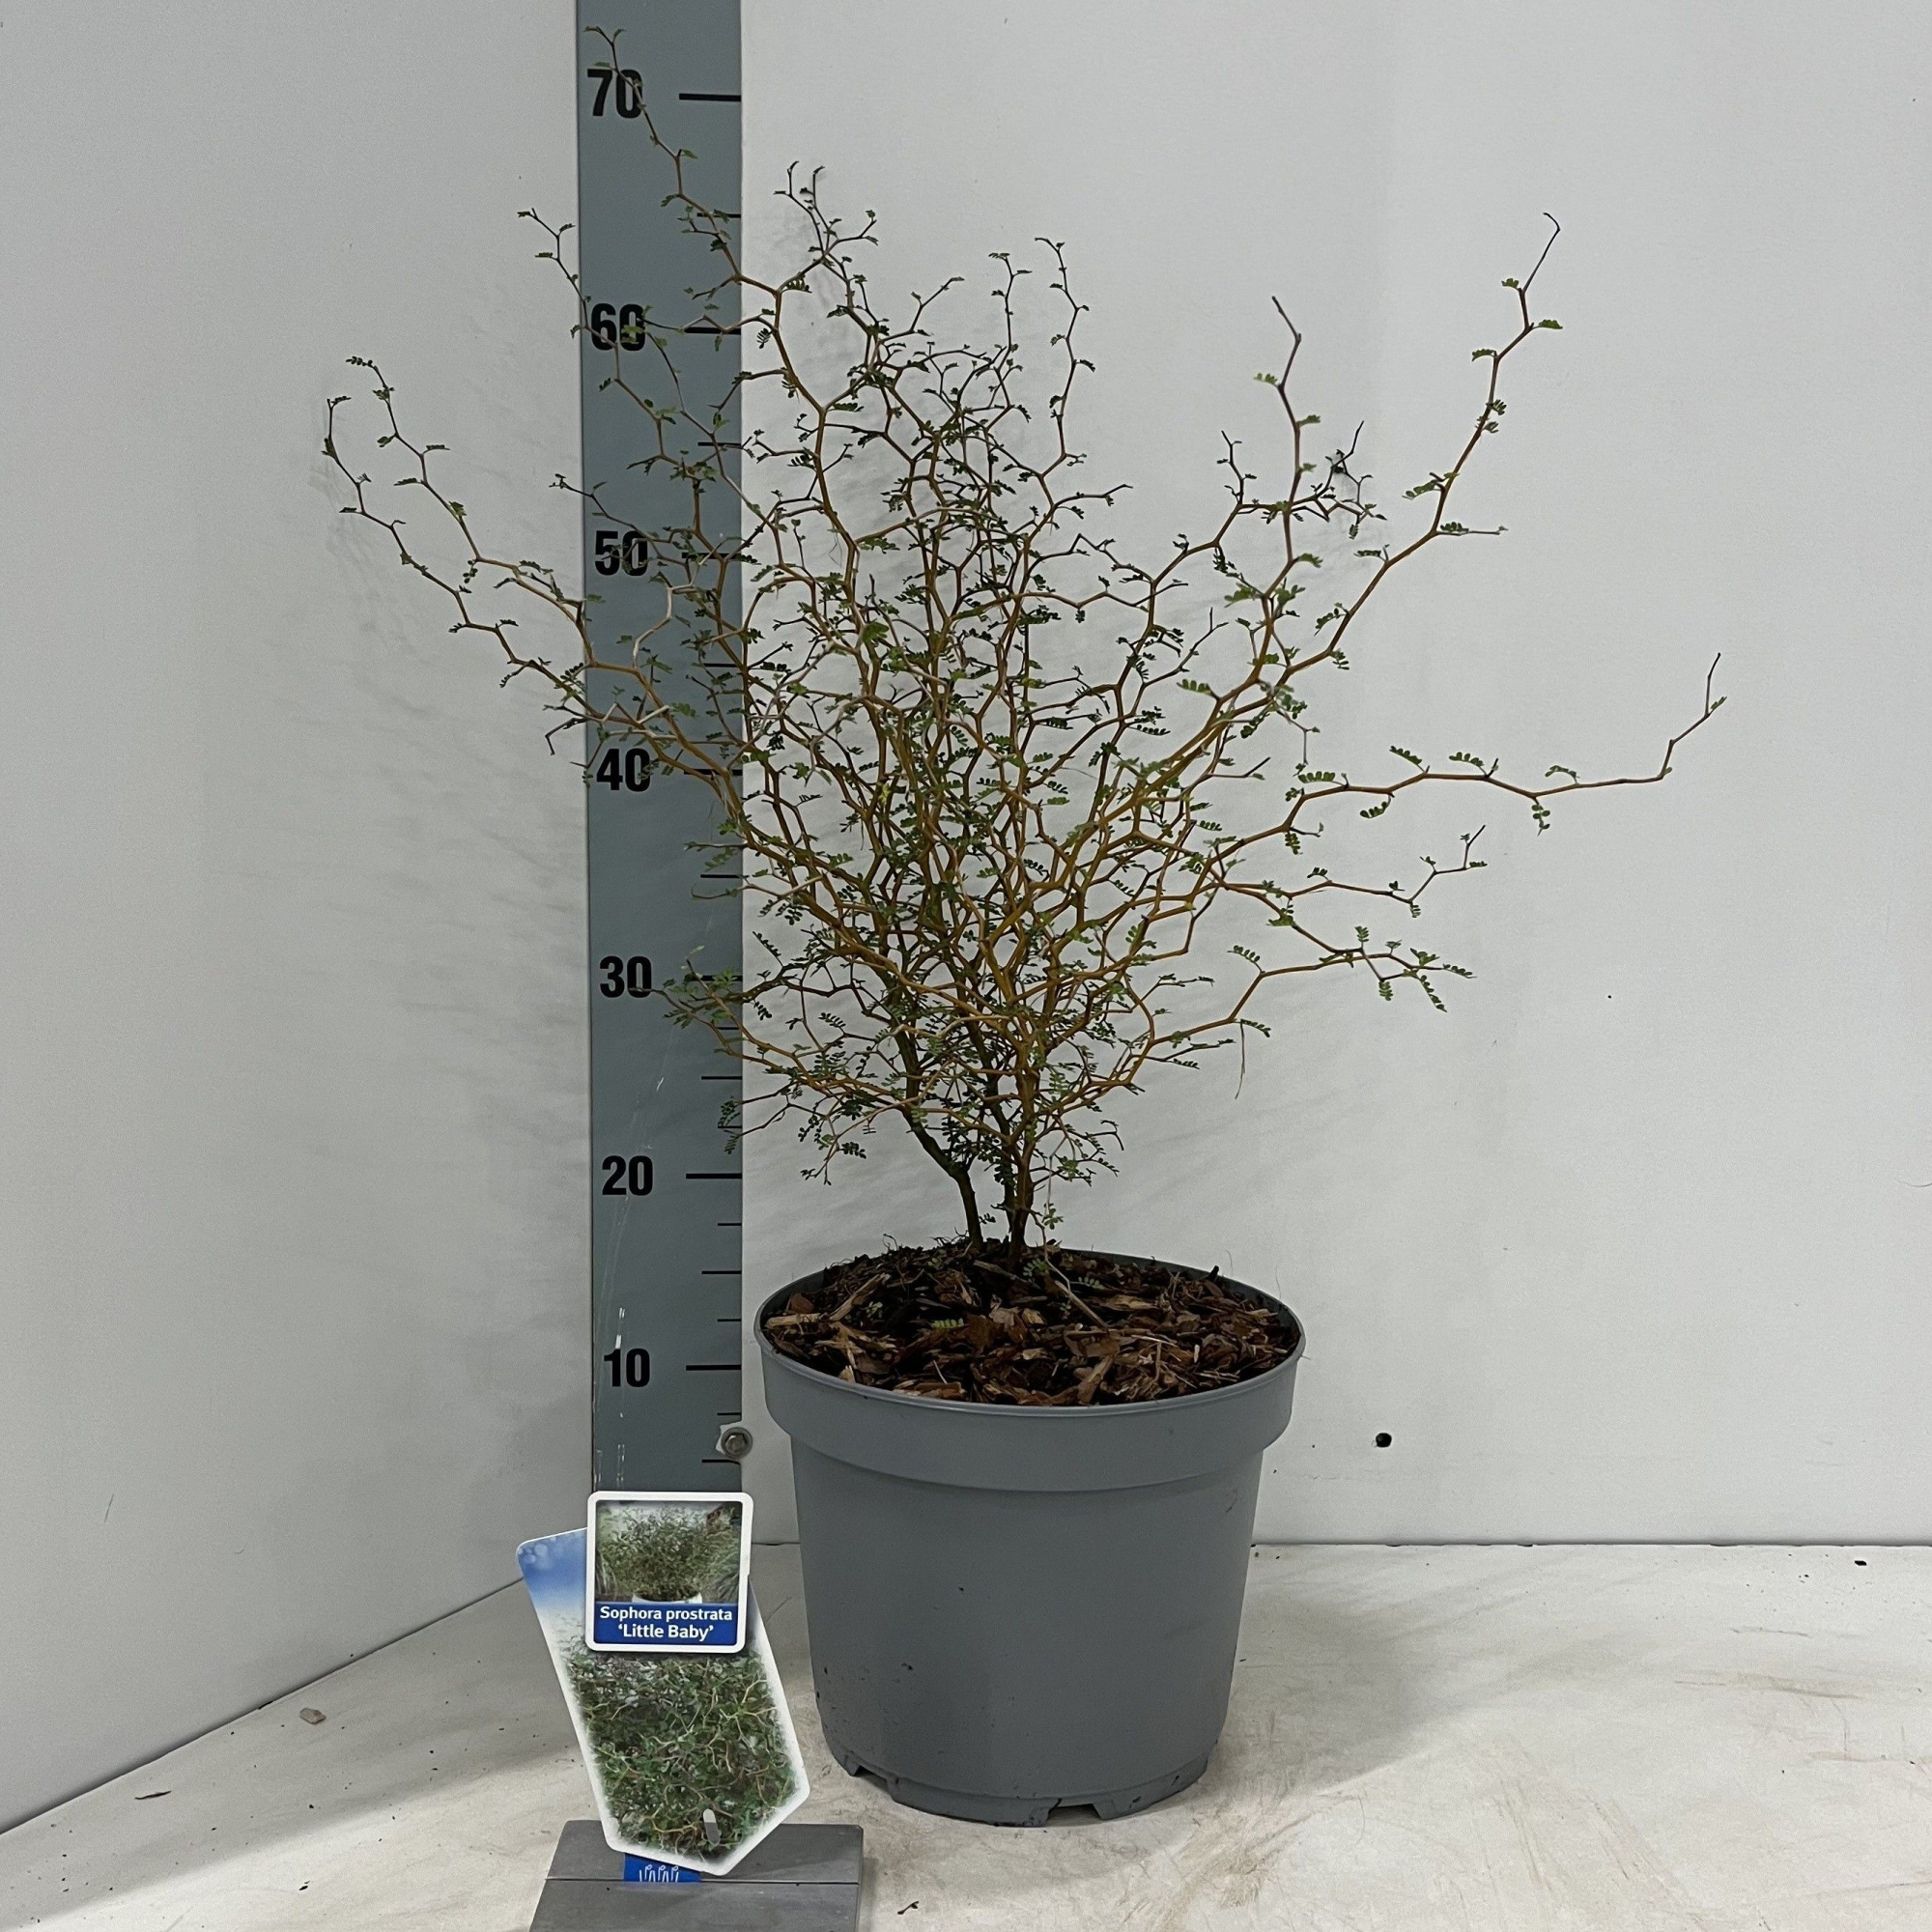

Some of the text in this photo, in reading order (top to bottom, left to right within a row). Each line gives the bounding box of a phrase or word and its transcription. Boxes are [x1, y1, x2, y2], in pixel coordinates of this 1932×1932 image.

[587, 69, 644, 119] 70
[590, 302, 646, 352] 60
[594, 530, 648, 577] 50
[596, 748, 651, 792] 40
[599, 955, 652, 999] 30
[602, 1155, 654, 1197] 20
[604, 1349, 650, 1387] 10
[599, 1605, 733, 1623] Sophora prostrata
